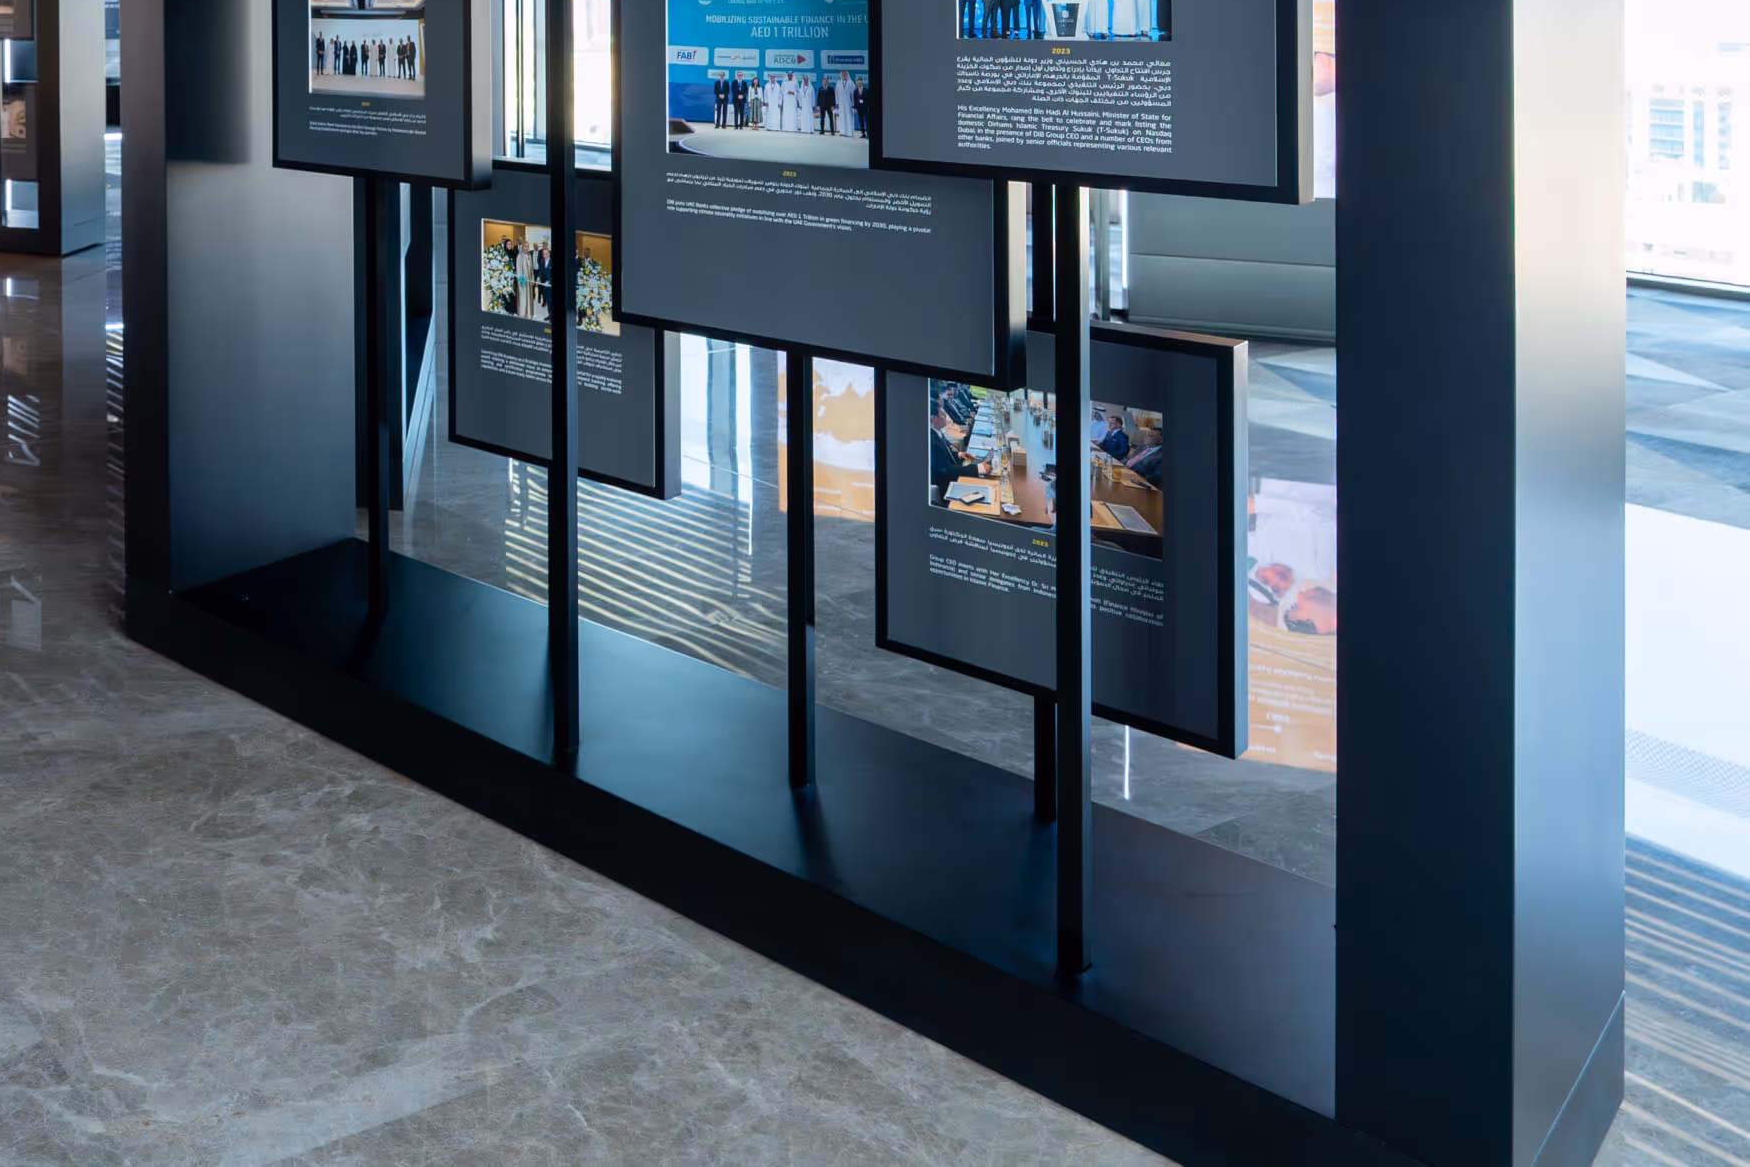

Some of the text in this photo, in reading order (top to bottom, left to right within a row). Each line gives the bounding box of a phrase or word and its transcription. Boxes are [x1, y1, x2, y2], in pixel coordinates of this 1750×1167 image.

[748, 15, 799, 24] SUSTAINABLE
[801, 15, 834, 24] FINANCE
[751, 26, 829, 38] AED 1 TRILLION
[676, 51, 694, 60] FAB
[773, 56, 796, 65] ADCB
[969, 105, 1000, 114] Excellency
[1135, 121, 1156, 129] listing
[996, 130, 1024, 138] presence
[1046, 131, 1065, 140] Group
[1042, 124, 1069, 132] Treasury
[1097, 126, 1129, 135] (T-Sukuk)
[1146, 129, 1172, 137] Nasdaq
[996, 136, 1015, 145] joined
[1016, 137, 1024, 145] by
[1073, 141, 1115, 151] representing
[1117, 143, 1142, 151] various
[1143, 145, 1171, 153] relevant
